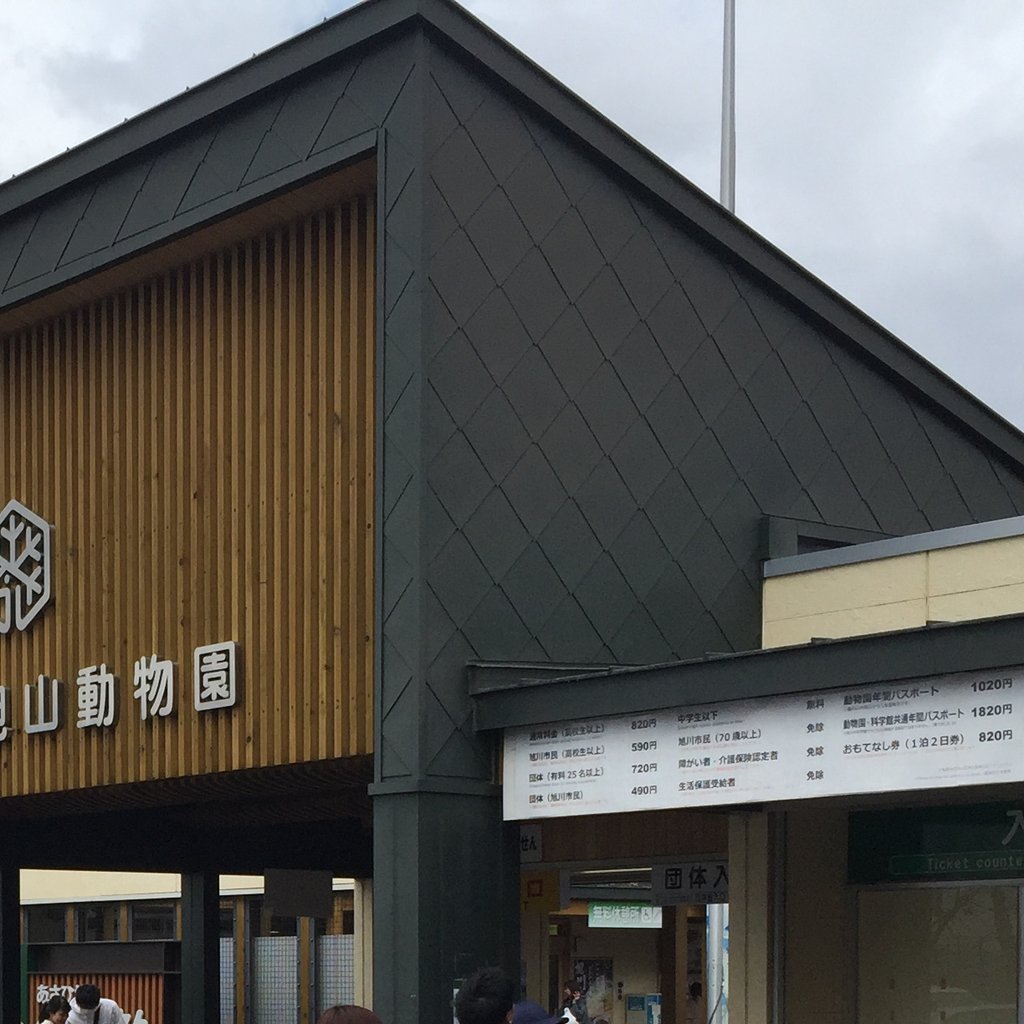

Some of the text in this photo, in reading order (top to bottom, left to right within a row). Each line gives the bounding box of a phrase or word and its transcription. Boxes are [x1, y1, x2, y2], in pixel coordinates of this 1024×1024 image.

[971, 678, 1013, 693] 1020円
[677, 710, 718, 724] 中学生以下
[971, 703, 1013, 718] 1820円
[631, 718, 657, 730] 820円
[978, 729, 1013, 743] 820円
[631, 740, 657, 752] 590円
[631, 762, 658, 774] 720円
[631, 785, 658, 796] 490円
[928, 858, 969, 871] Ticket
